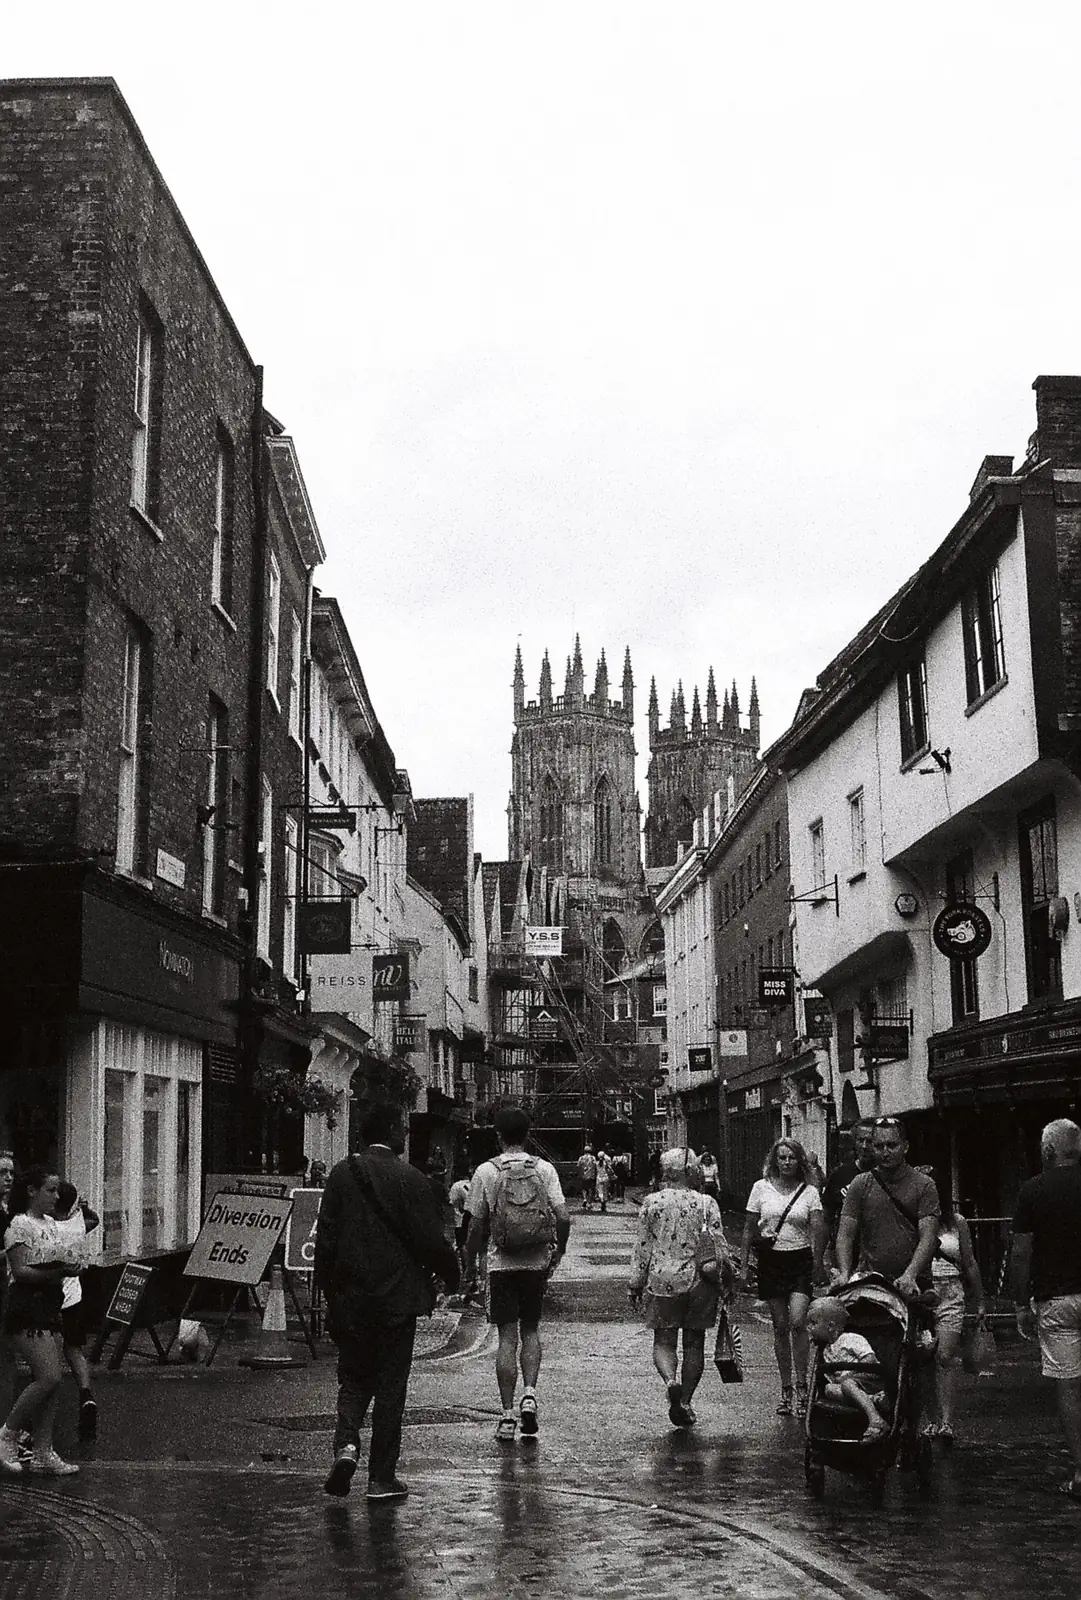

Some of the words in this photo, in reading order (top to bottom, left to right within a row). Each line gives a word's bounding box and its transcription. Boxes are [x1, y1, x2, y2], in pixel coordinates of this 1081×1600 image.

[318, 976, 367, 986] REISS
[763, 980, 786, 988] MISS
[764, 988, 786, 996] DIVA
[208, 1204, 282, 1231] Diversion
[207, 1241, 249, 1265] Ends
